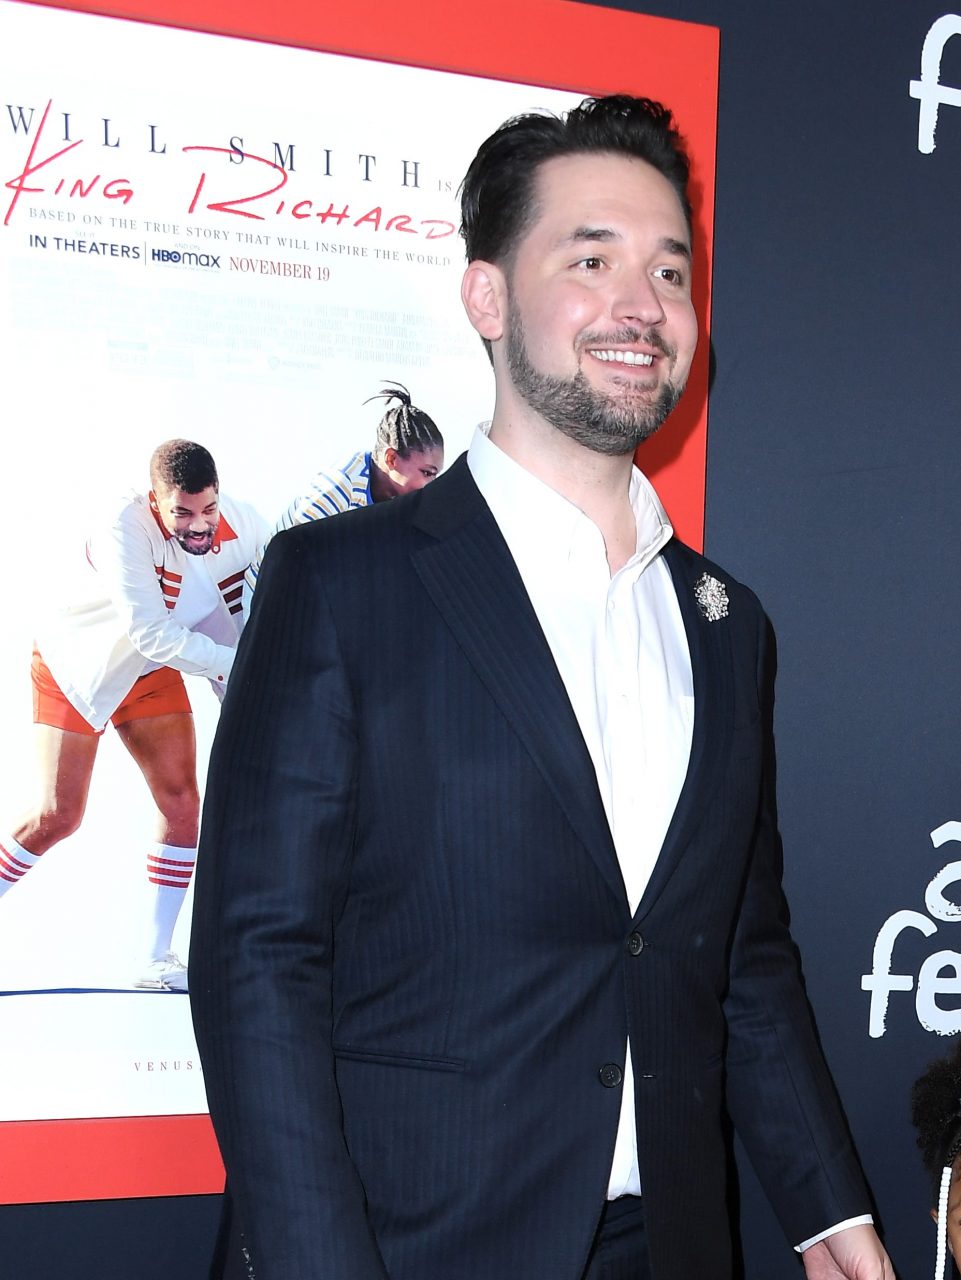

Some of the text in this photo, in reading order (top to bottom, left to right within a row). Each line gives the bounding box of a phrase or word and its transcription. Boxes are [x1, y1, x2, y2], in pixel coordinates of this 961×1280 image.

[5, 98, 456, 240] KING RICHARD
[6, 104, 453, 192] WILL SMITH IS
[29, 207, 451, 266] BASED ON THE TRUE STORY THAT WILL INSPIRE THE WORLD
[29, 234, 47, 248] IN
[53, 237, 140, 259] THEATERS
[229, 256, 312, 279] NOVEMBER
[317, 267, 330, 281] 19
